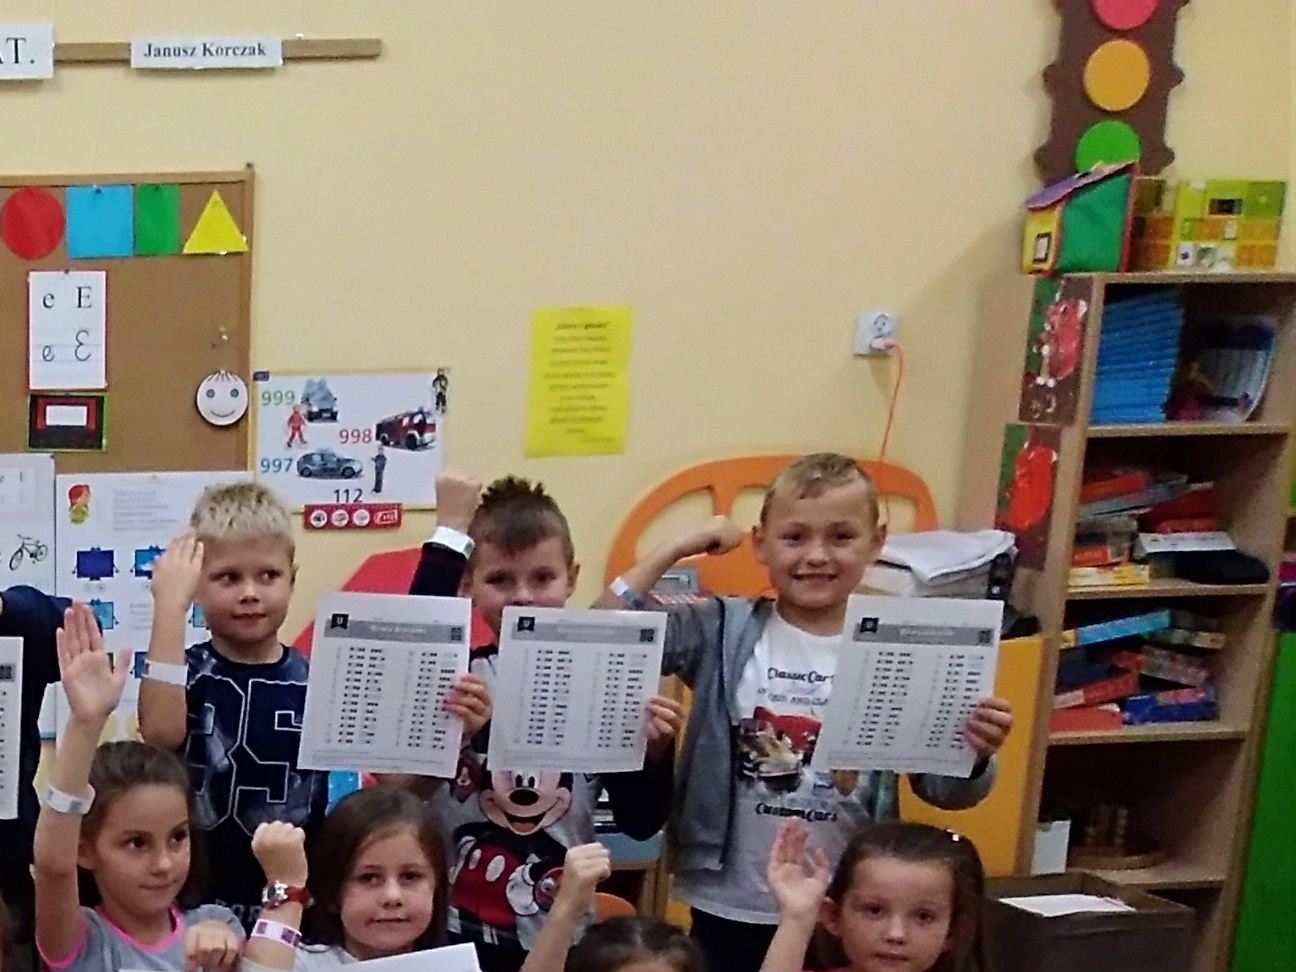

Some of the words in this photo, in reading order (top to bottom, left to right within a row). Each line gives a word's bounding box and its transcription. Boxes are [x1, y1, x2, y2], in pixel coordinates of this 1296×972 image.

[144, 42, 197, 58] Janusz
[202, 42, 267, 58] Korczak
[42, 292, 54, 309] e
[76, 286, 92, 309] E
[261, 390, 295, 406] 999
[339, 428, 372, 444] 998
[260, 458, 293, 473] 997
[334, 488, 363, 503] 112
